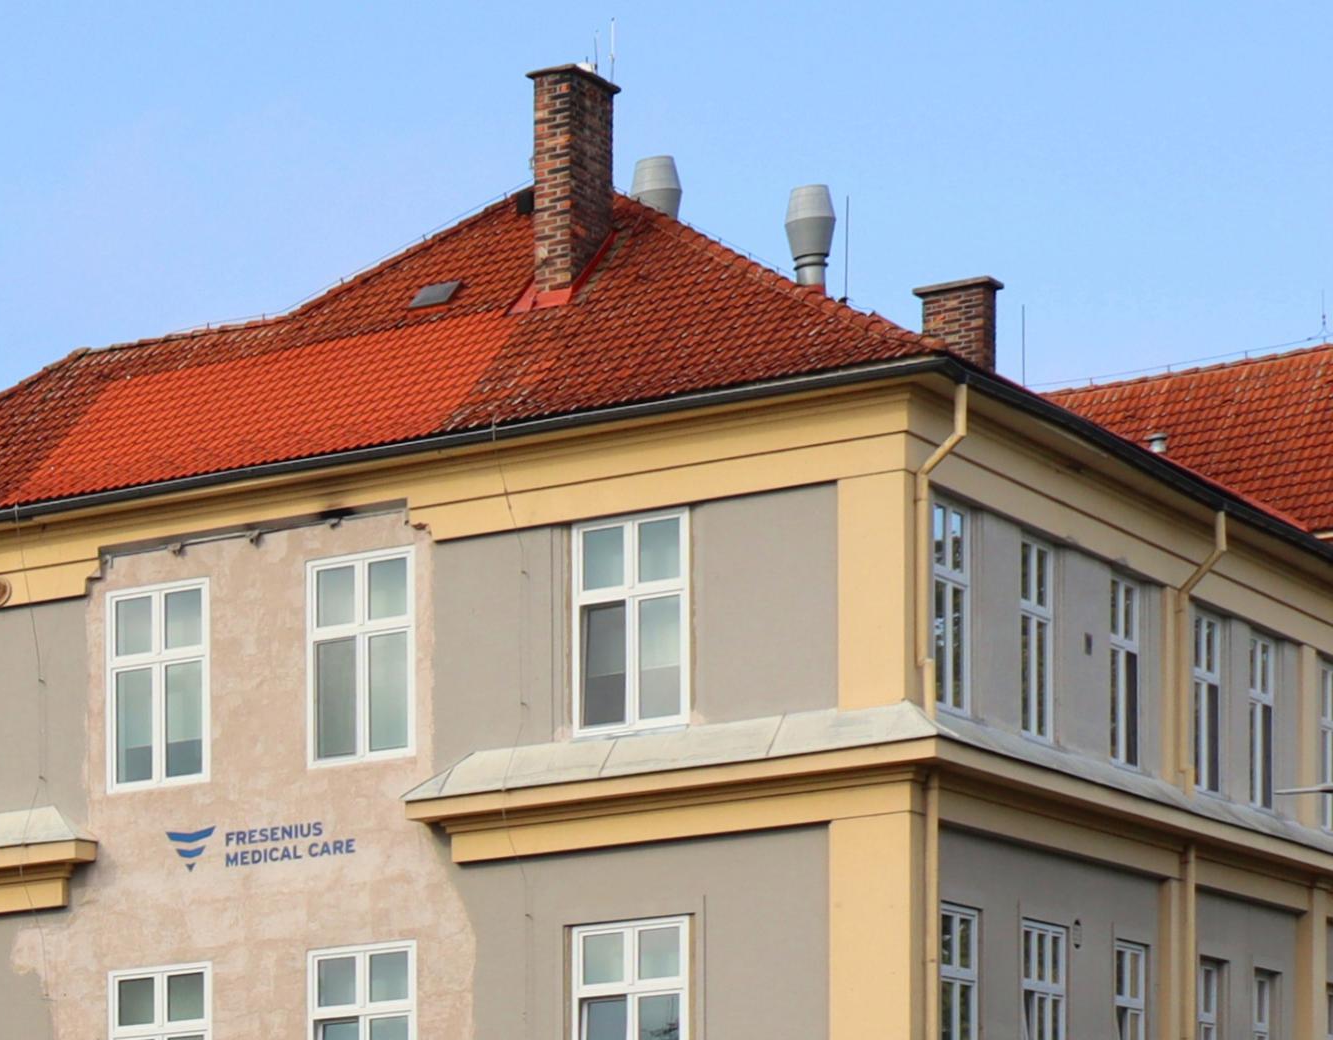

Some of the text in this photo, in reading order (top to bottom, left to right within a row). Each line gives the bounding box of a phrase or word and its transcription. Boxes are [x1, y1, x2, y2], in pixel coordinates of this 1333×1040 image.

[225, 822, 323, 847] FRESENIUS
[225, 838, 356, 868] MEDICAL CARE
